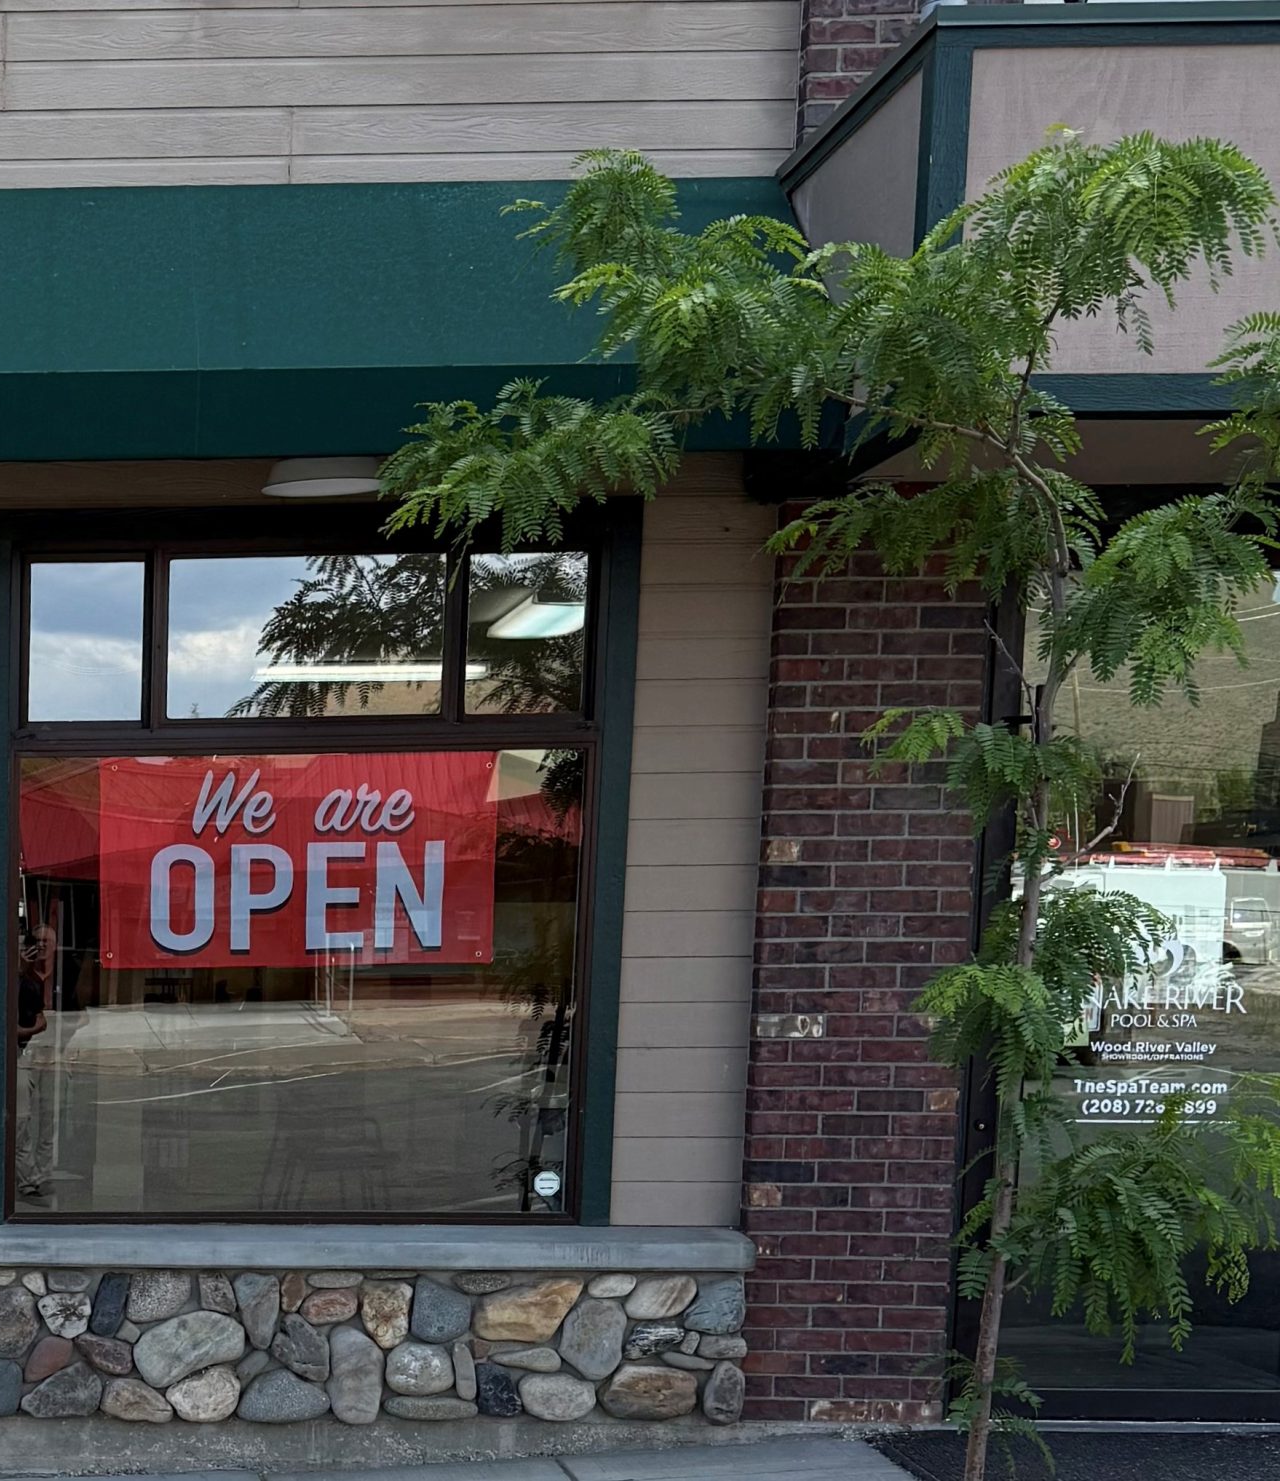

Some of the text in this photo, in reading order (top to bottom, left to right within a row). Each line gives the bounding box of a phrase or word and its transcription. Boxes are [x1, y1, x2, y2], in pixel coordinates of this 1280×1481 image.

[192, 768, 415, 835] We are
[150, 840, 446, 953] OPEN
[1078, 984, 1248, 1014] NAKE RIVER
[1090, 1041, 1217, 1055] Wood River Valley
[1081, 1099, 1131, 1116] (208)
